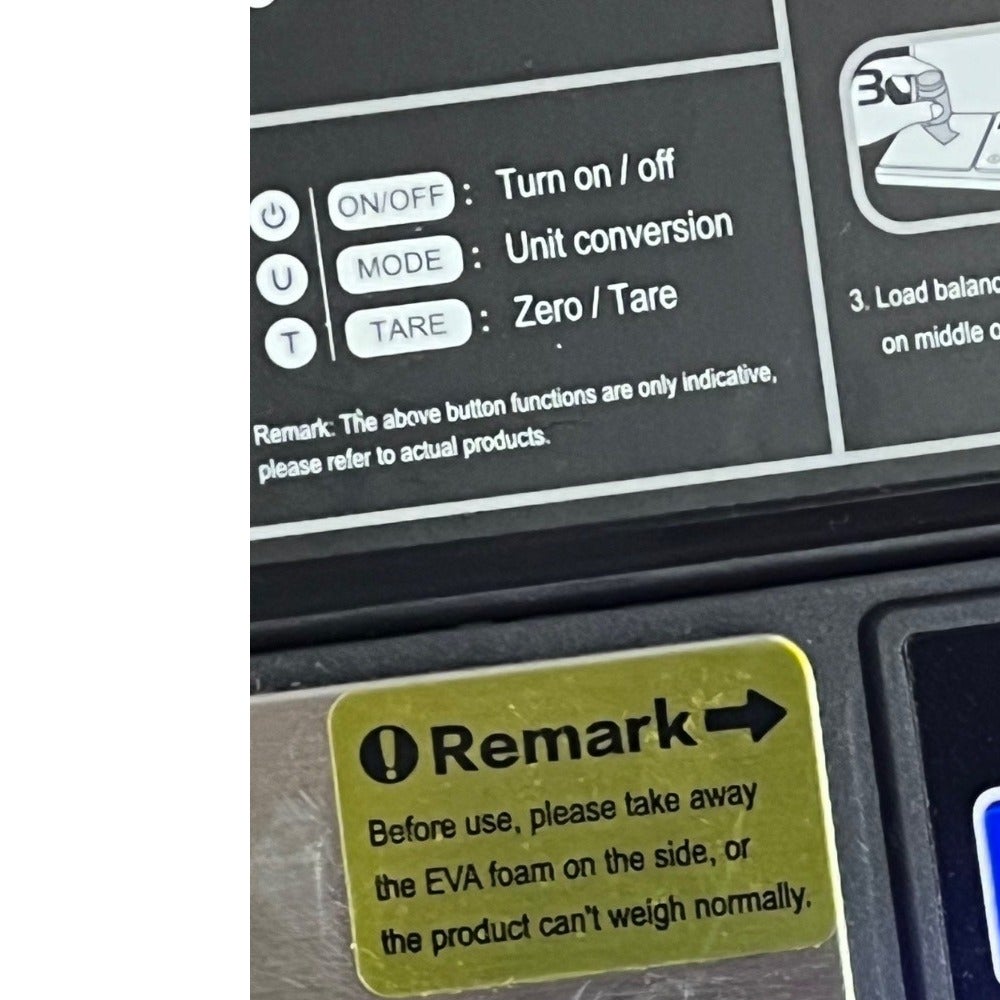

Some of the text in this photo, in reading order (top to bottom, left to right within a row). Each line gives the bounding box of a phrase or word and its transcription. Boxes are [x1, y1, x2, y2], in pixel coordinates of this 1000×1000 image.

[337, 184, 445, 218] ON/OFF
[496, 168, 566, 200] Turn
[574, 161, 612, 190] on
[638, 147, 676, 182] off
[357, 249, 443, 280] MODE
[505, 227, 567, 263] Unit
[573, 210, 733, 254] conversion
[271, 266, 293, 291] U
[849, 289, 869, 313] 3.
[875, 283, 929, 309] Load
[281, 331, 300, 354] T
[370, 313, 448, 343] TARE
[514, 292, 583, 328] Zero
[607, 282, 678, 315] Tare
[881, 334, 909, 354] on
[915, 320, 984, 351] middle
[254, 363, 778, 445] Remark: The above button functions are only indicative,
[258, 426, 551, 484] please refer to actual products.
[430, 697, 697, 776] Remark
[369, 782, 758, 847] Before use, please take away
[375, 838, 751, 900] the EVA foam on the side, or
[381, 881, 812, 957] the product can't weigh normally.
